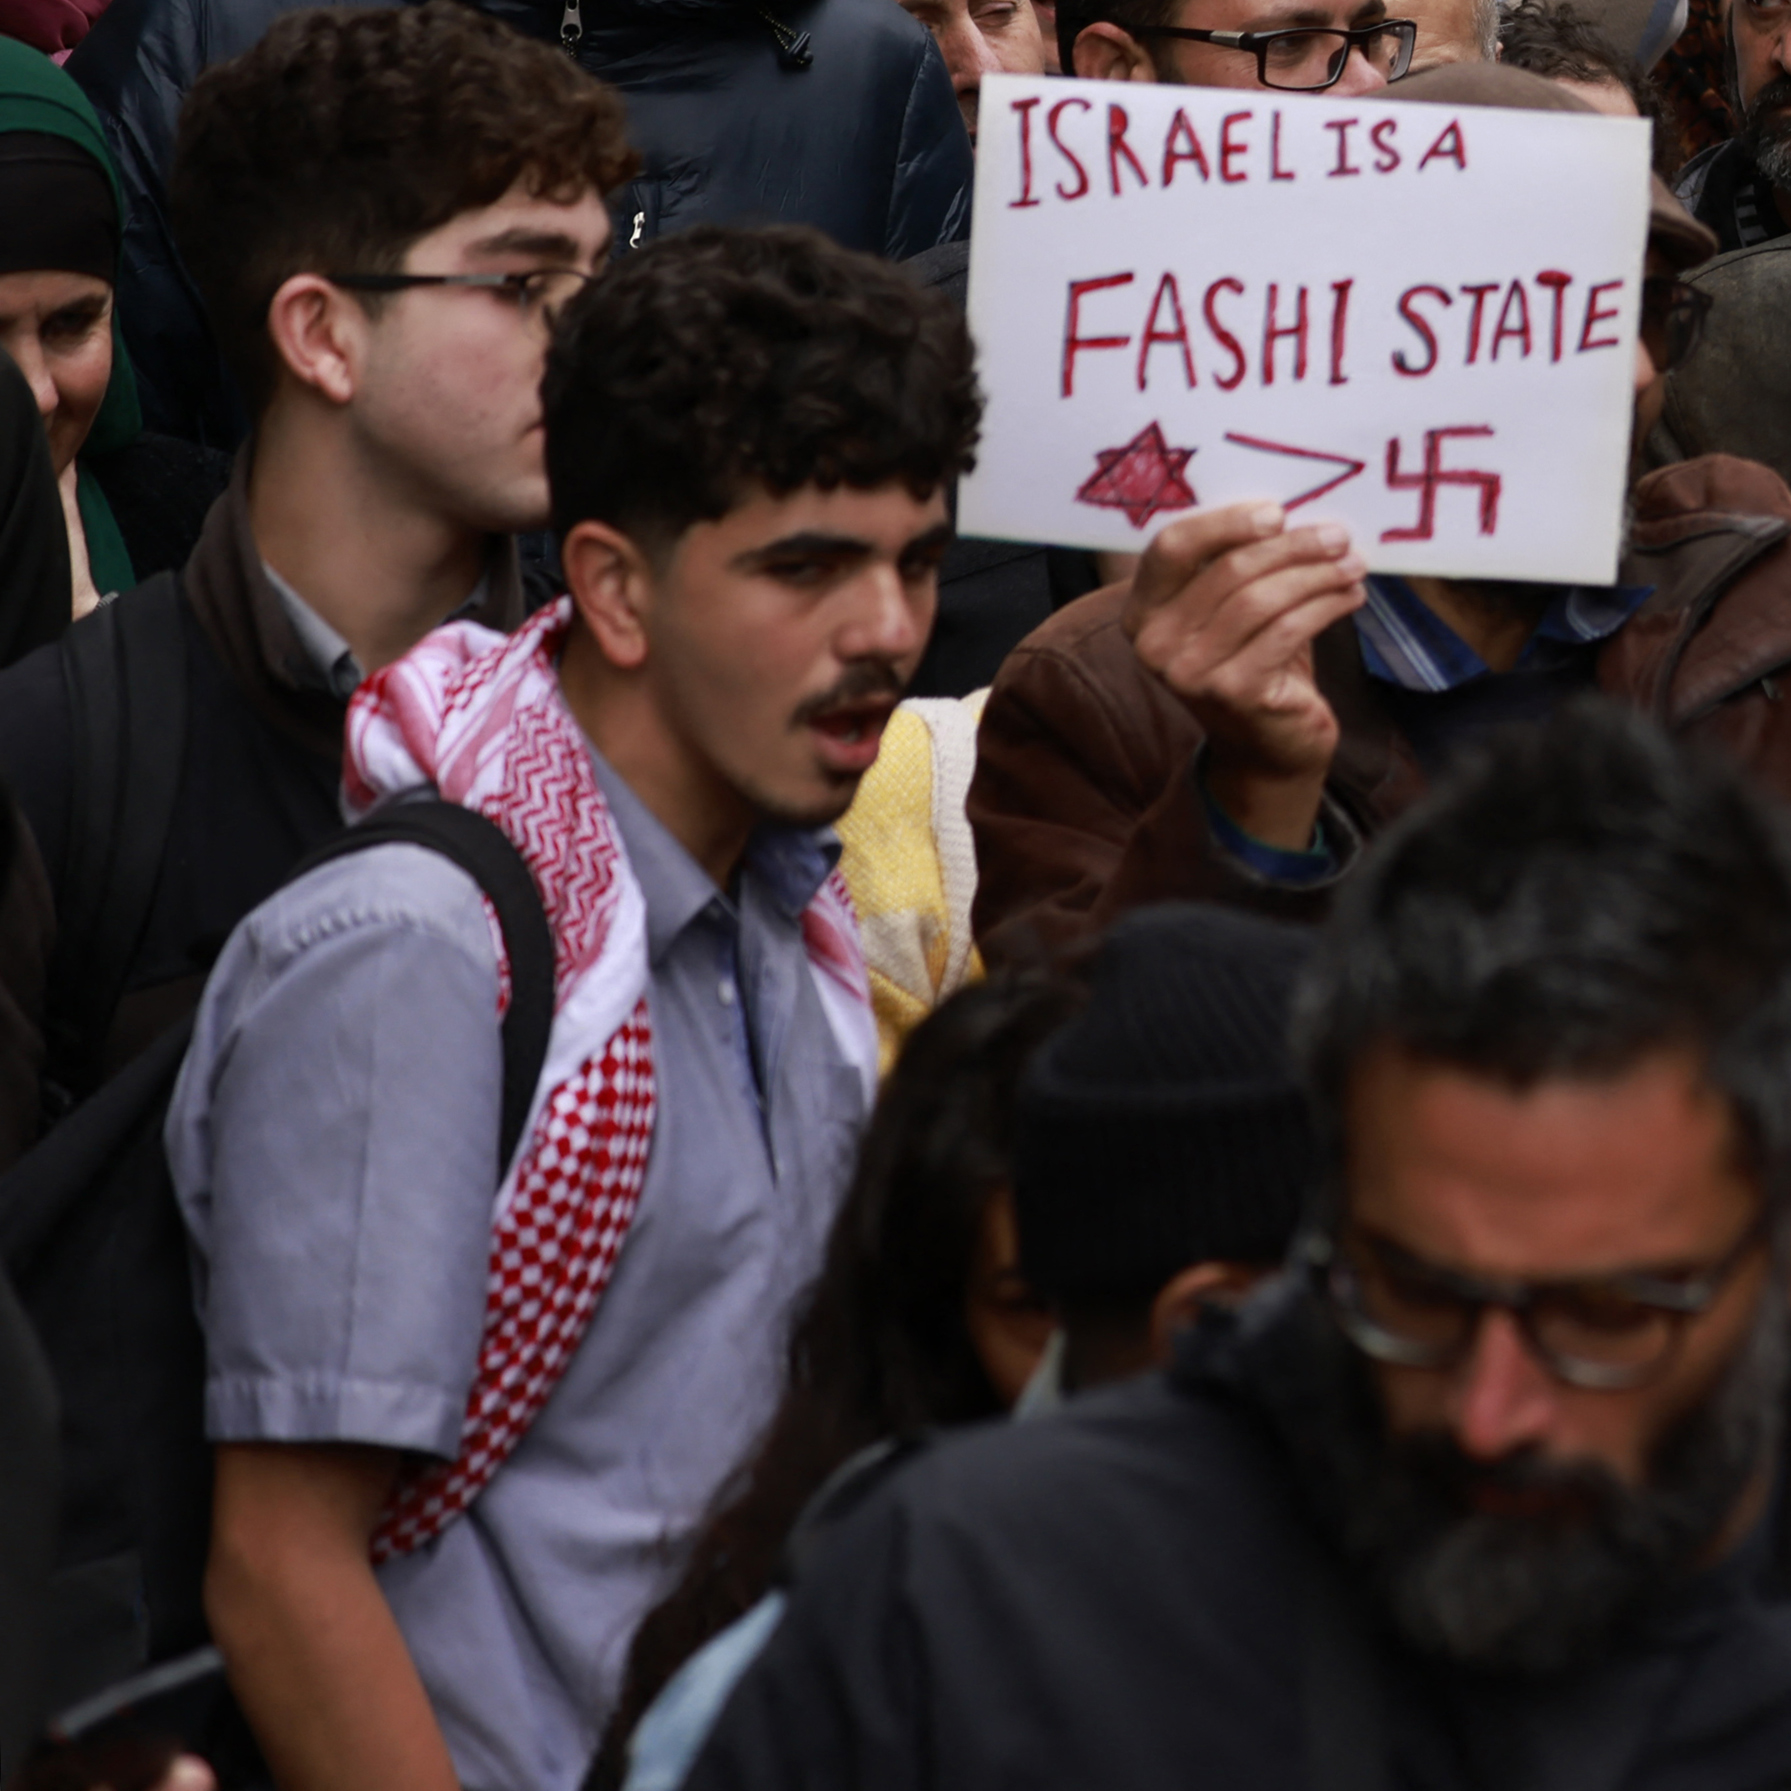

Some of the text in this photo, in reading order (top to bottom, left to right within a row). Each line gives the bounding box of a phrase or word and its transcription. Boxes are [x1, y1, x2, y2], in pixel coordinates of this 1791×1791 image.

[1008, 97, 1468, 209] ISRAEL IS A
[1060, 270, 1625, 399] FASHI STATE
